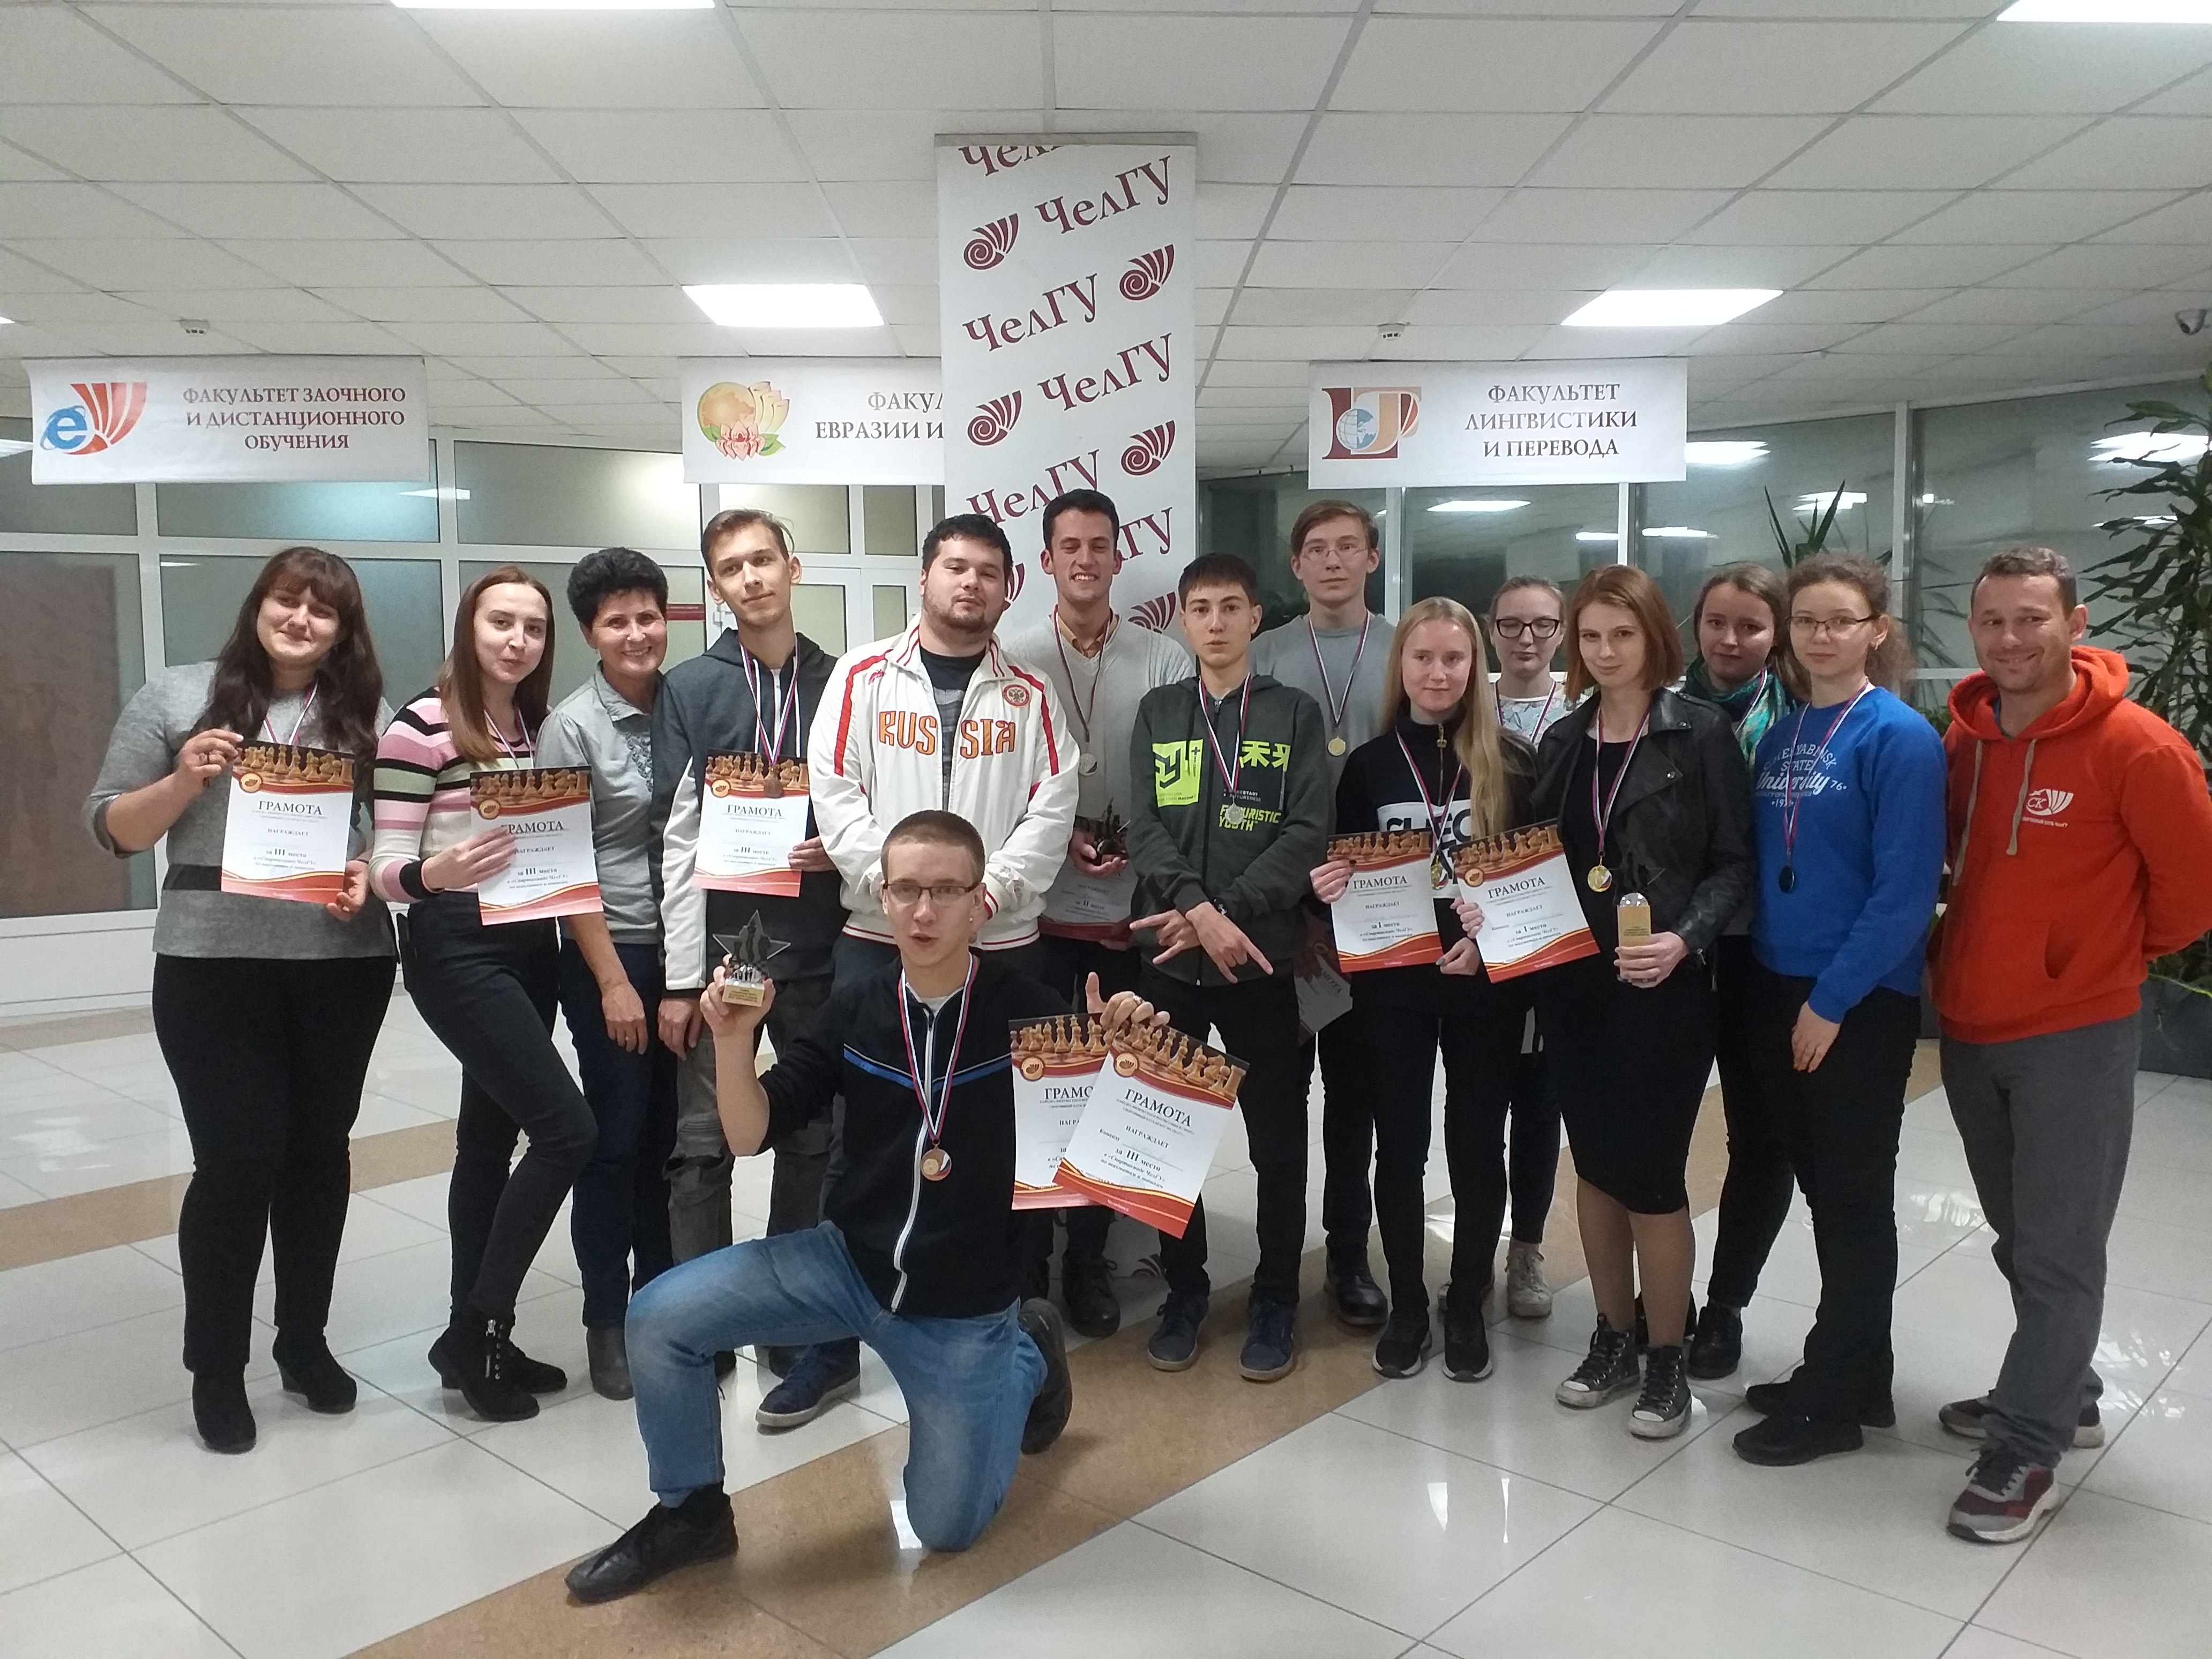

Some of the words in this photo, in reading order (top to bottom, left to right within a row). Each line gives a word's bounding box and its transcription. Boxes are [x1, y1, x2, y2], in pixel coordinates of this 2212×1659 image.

[1035, 155, 1171, 234] ЧелГУ
[962, 273, 1097, 352] ЧелГУ
[1038, 333, 1172, 411] ЧелГУ
[183, 386, 299, 406] ФАКУЛЬТЕТ
[303, 387, 406, 403] ЗАОЧНОГО
[1488, 383, 1620, 405] ФАКУЛЬТЕТ
[186, 411, 201, 427] И
[206, 410, 405, 430] ДИСТАНЦИОННОГО
[815, 421, 920, 439] ЕВРАЗИИ
[1464, 410, 1638, 431] ЛИНГВИСТИКИ
[244, 434, 349, 451] ОБУЧЕНИЯ
[1483, 440, 1500, 458] И
[1506, 438, 1619, 460] ПЕРЕВОДА
[966, 449, 1100, 524] ЧелГУ
[1781, 759, 1814, 772] SATE
[258, 800, 323, 816] ГРАМОТА
[727, 804, 782, 817] ГРАМОТА
[1220, 804, 1282, 824] FURISTIC
[1353, 875, 1408, 890] ГРАМОТА
[1488, 876, 1546, 899] ГРАМОТА
[1124, 1088, 1191, 1127] ГРАМОТА
[1125, 1125, 1170, 1148] НАГРАЖДАЕТ
[1126, 1150, 1139, 1162] III
